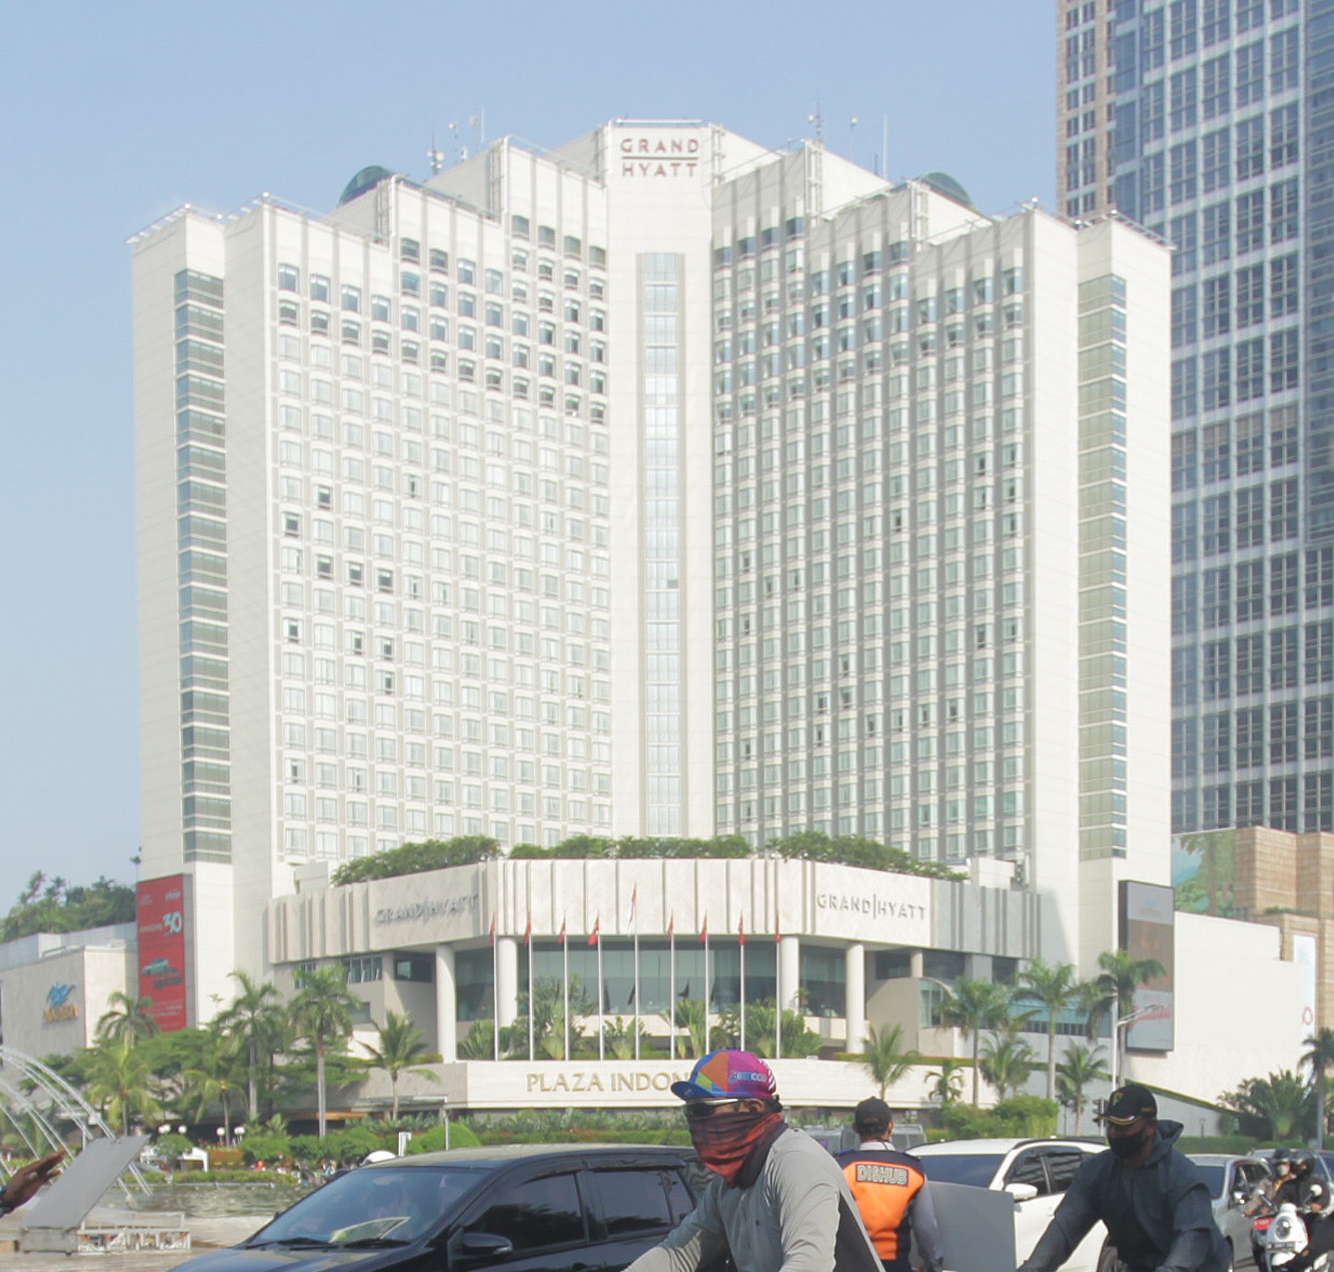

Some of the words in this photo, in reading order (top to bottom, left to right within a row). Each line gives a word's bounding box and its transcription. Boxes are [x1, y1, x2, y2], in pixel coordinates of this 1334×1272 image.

[620, 138, 699, 153] GRAND
[621, 162, 699, 177] HYATT
[375, 903, 424, 926] GRAND
[816, 893, 871, 914] GRAND
[877, 900, 926, 920] HYATT
[526, 1072, 604, 1092] PLAZA
[857, 1164, 908, 1186] DISHUB
